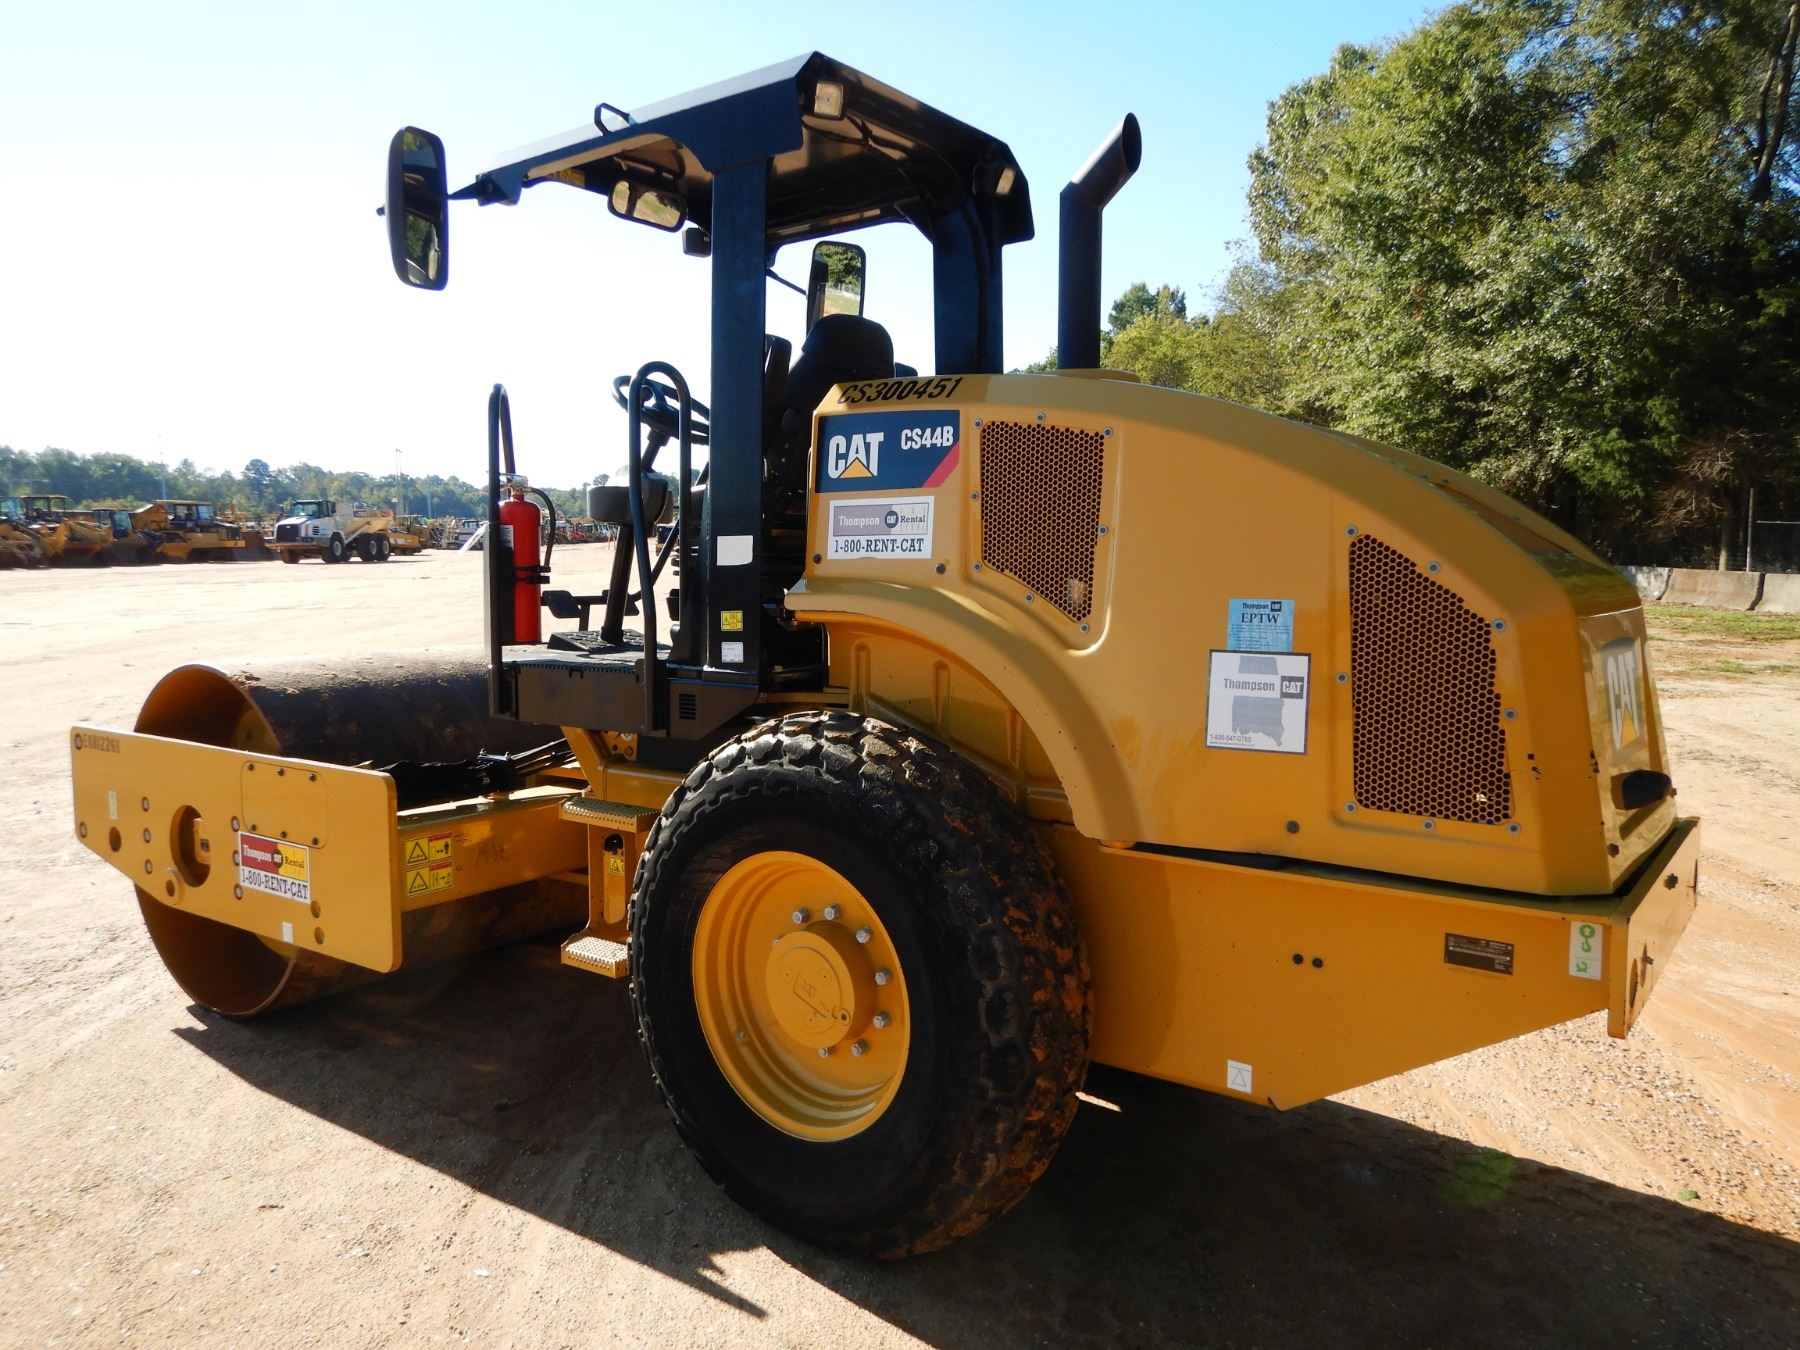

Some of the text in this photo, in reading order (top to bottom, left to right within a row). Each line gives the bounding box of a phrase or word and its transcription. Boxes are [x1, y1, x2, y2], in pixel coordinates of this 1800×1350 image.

[838, 377, 963, 404] CS300451
[828, 426, 954, 479] CAT CS44B
[838, 515, 926, 528] Thompson CAT Rental
[834, 538, 924, 553] 1-800-RENT-CAT
[1241, 613, 1280, 624] EPTW
[1224, 678, 1302, 693] Thompson CAT
[1607, 651, 1639, 749] CAT
[241, 868, 308, 900] 1-800-RENT-CAT
